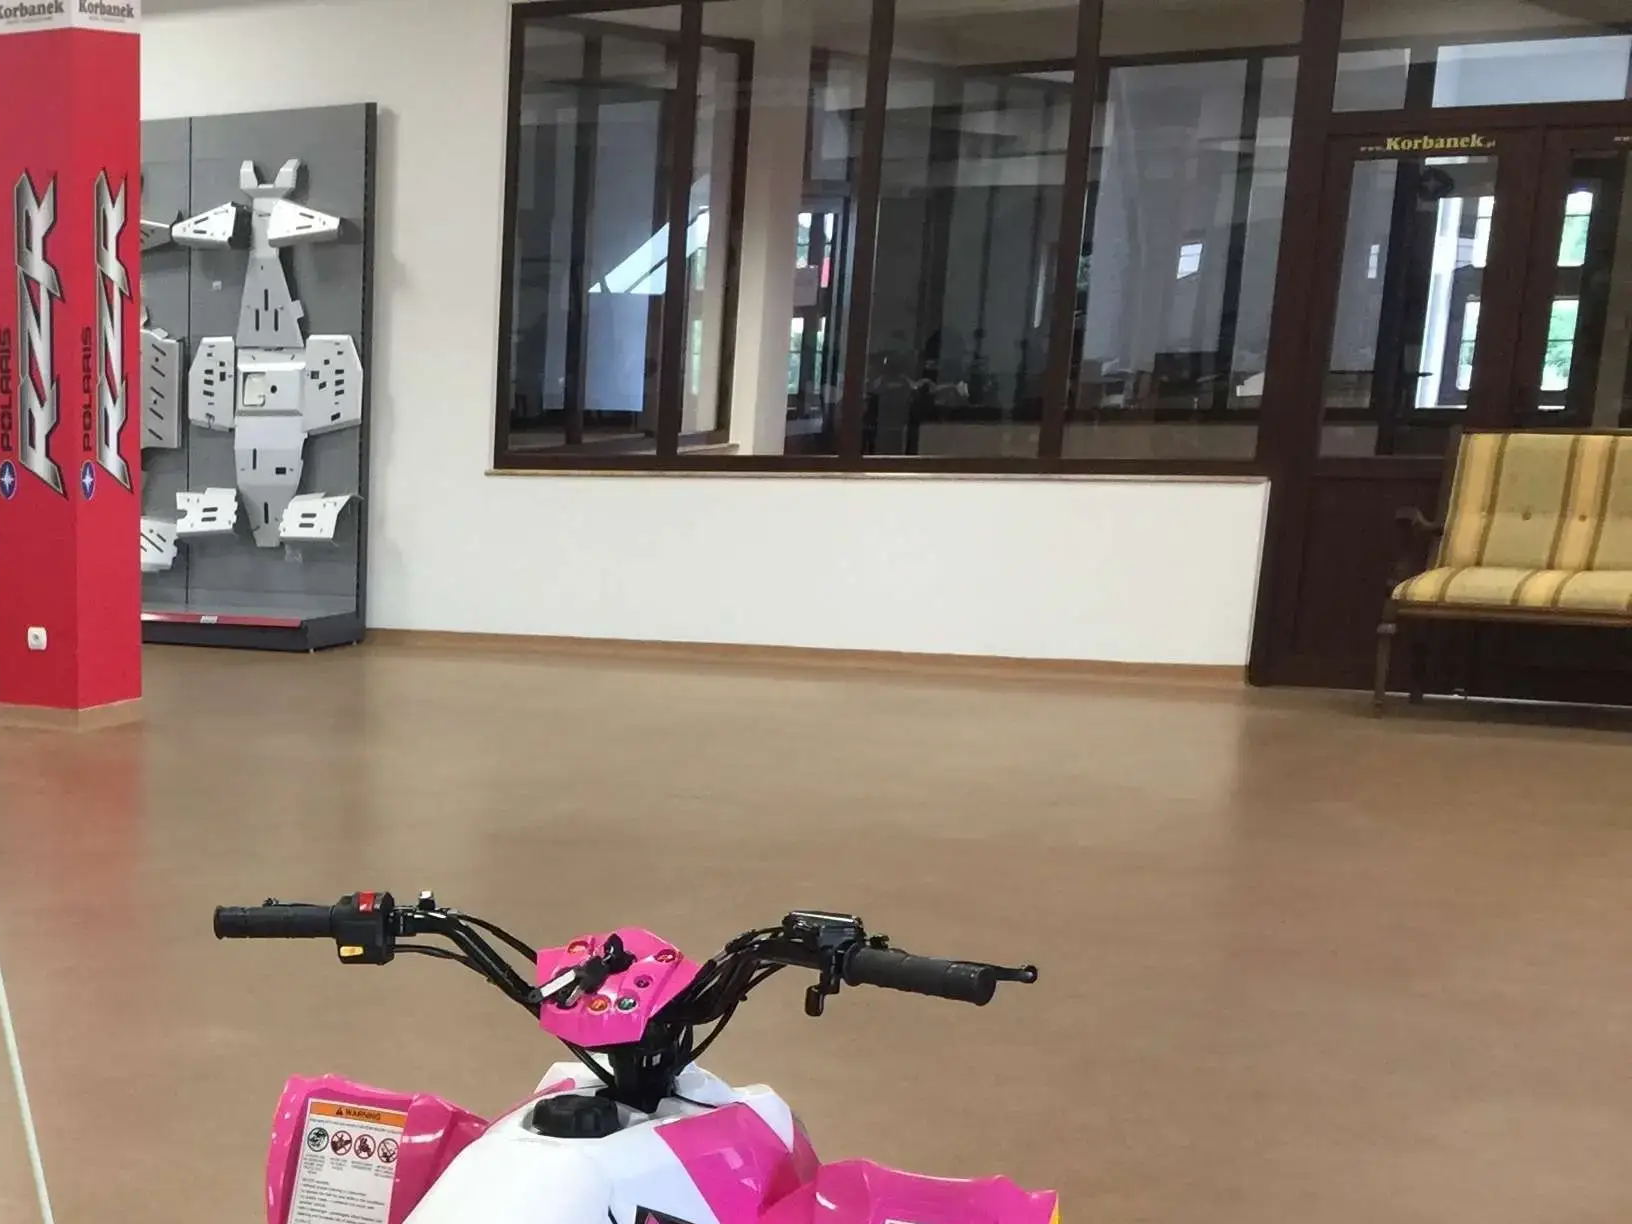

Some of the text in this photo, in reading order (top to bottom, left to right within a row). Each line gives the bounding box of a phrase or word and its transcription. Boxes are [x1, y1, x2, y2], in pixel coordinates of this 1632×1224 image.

[78, 0, 134, 18] Korbanek
[14, 167, 68, 501] RZR
[80, 326, 93, 452] POLARIS
[94, 166, 133, 495] RZR
[344, 1107, 381, 1122] WARNING
